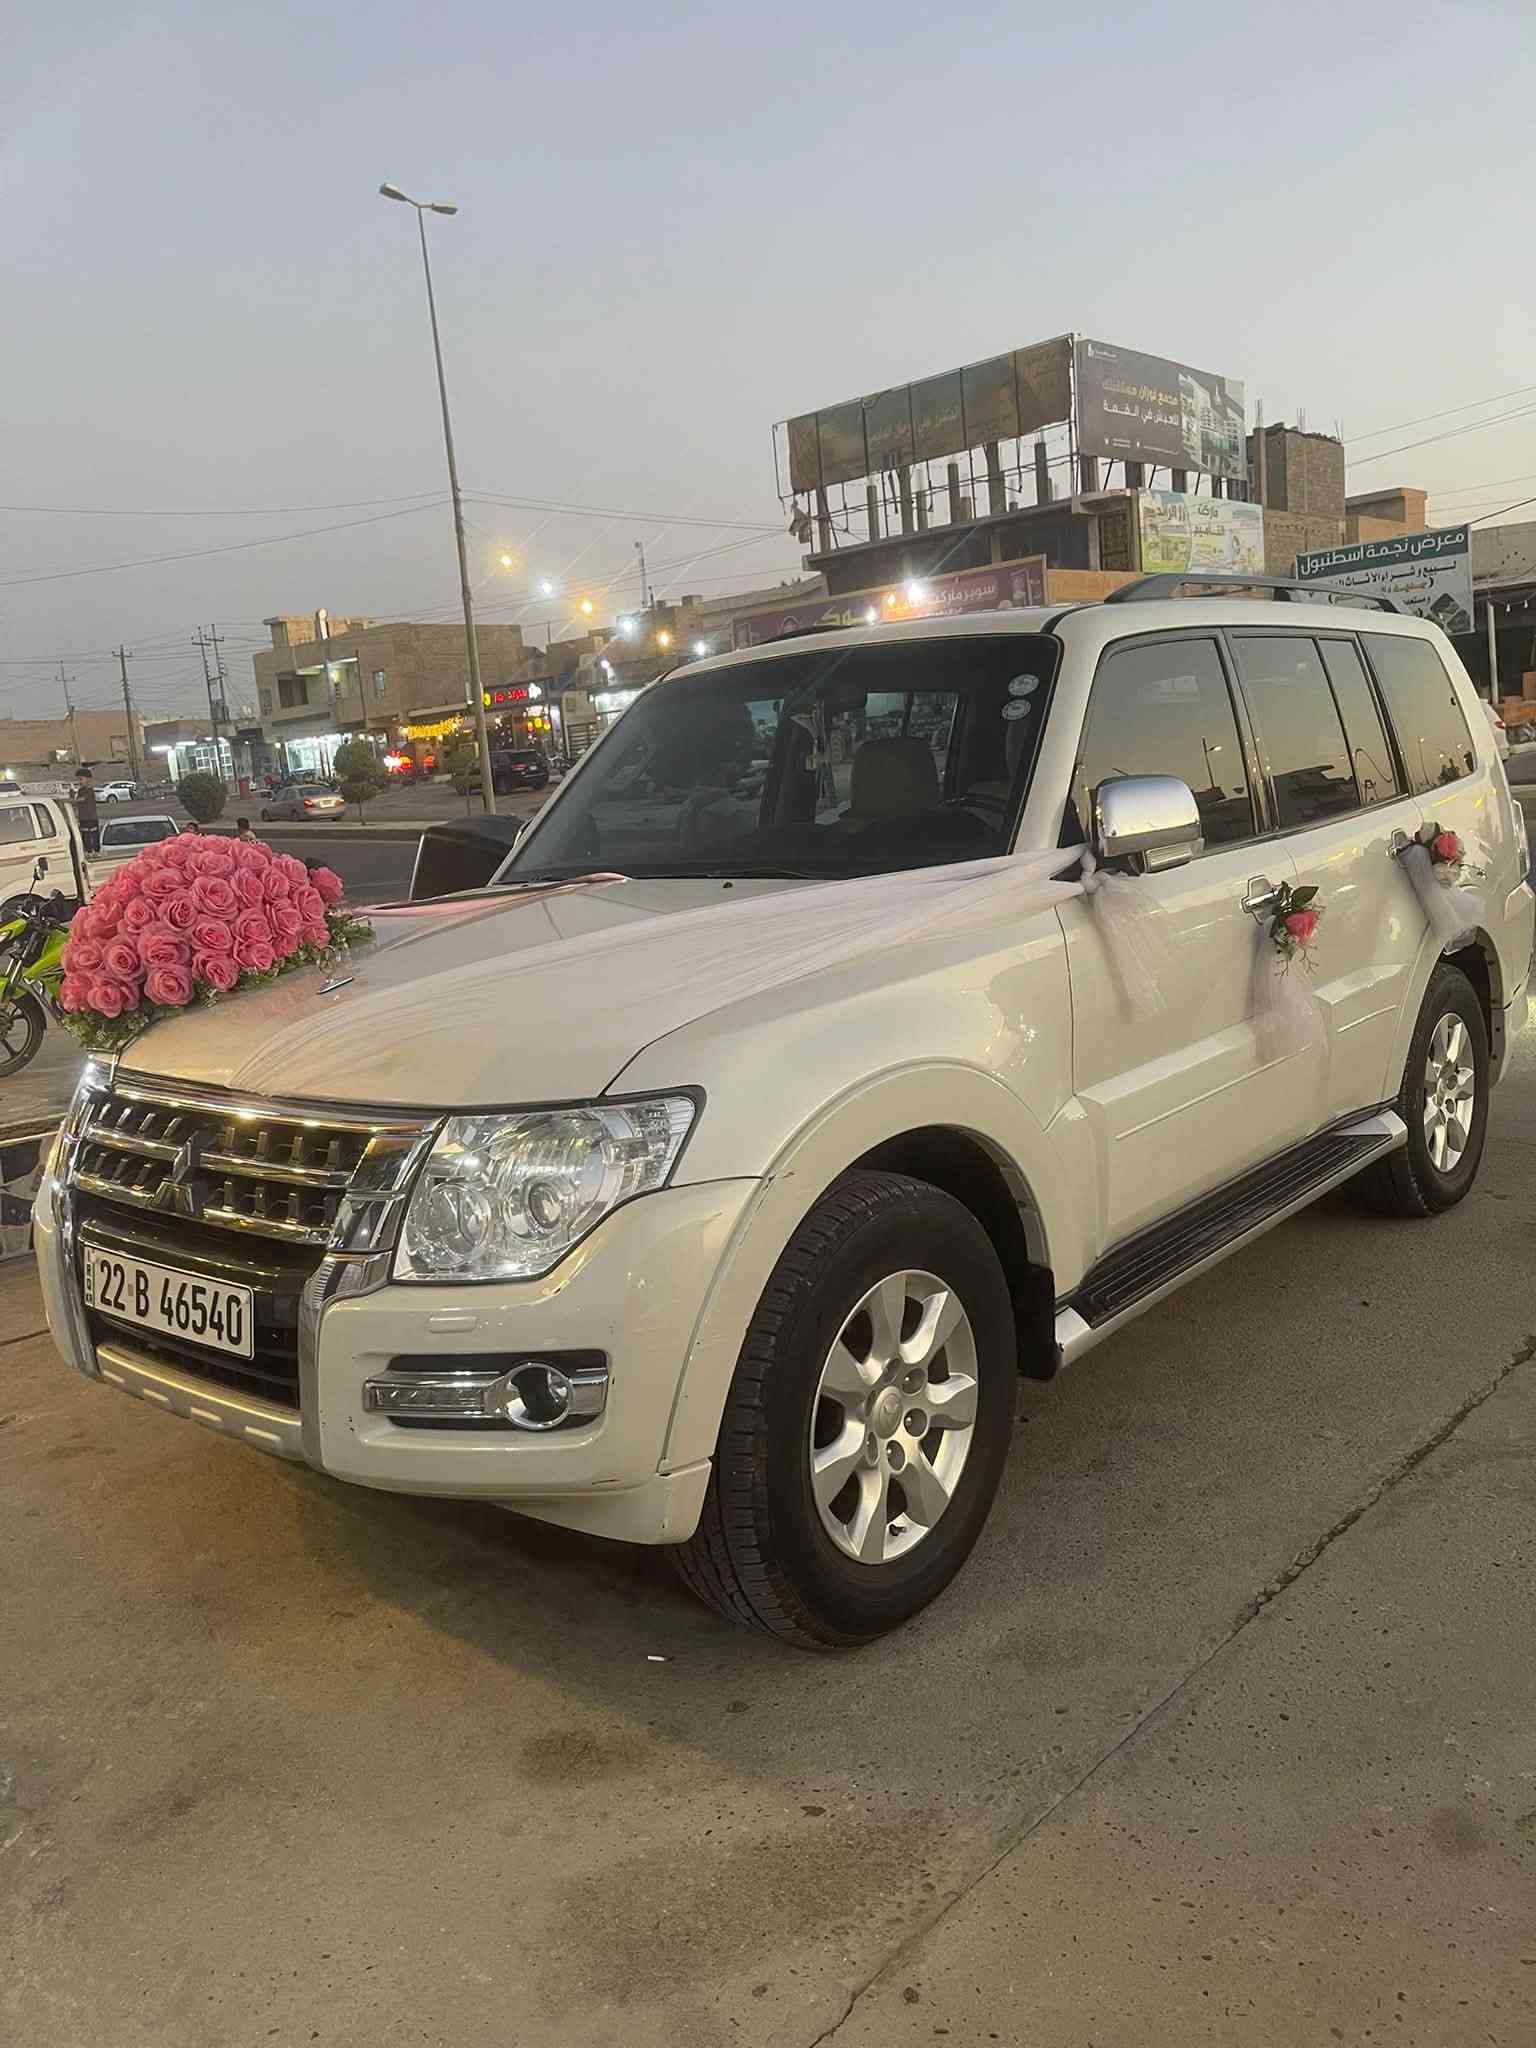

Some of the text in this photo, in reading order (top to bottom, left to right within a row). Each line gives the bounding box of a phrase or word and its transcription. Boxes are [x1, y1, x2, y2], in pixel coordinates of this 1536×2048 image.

[1300, 532, 1465, 576] معرض نجمة اسطنبول
[100, 1259, 242, 1346] 22 B 46540
